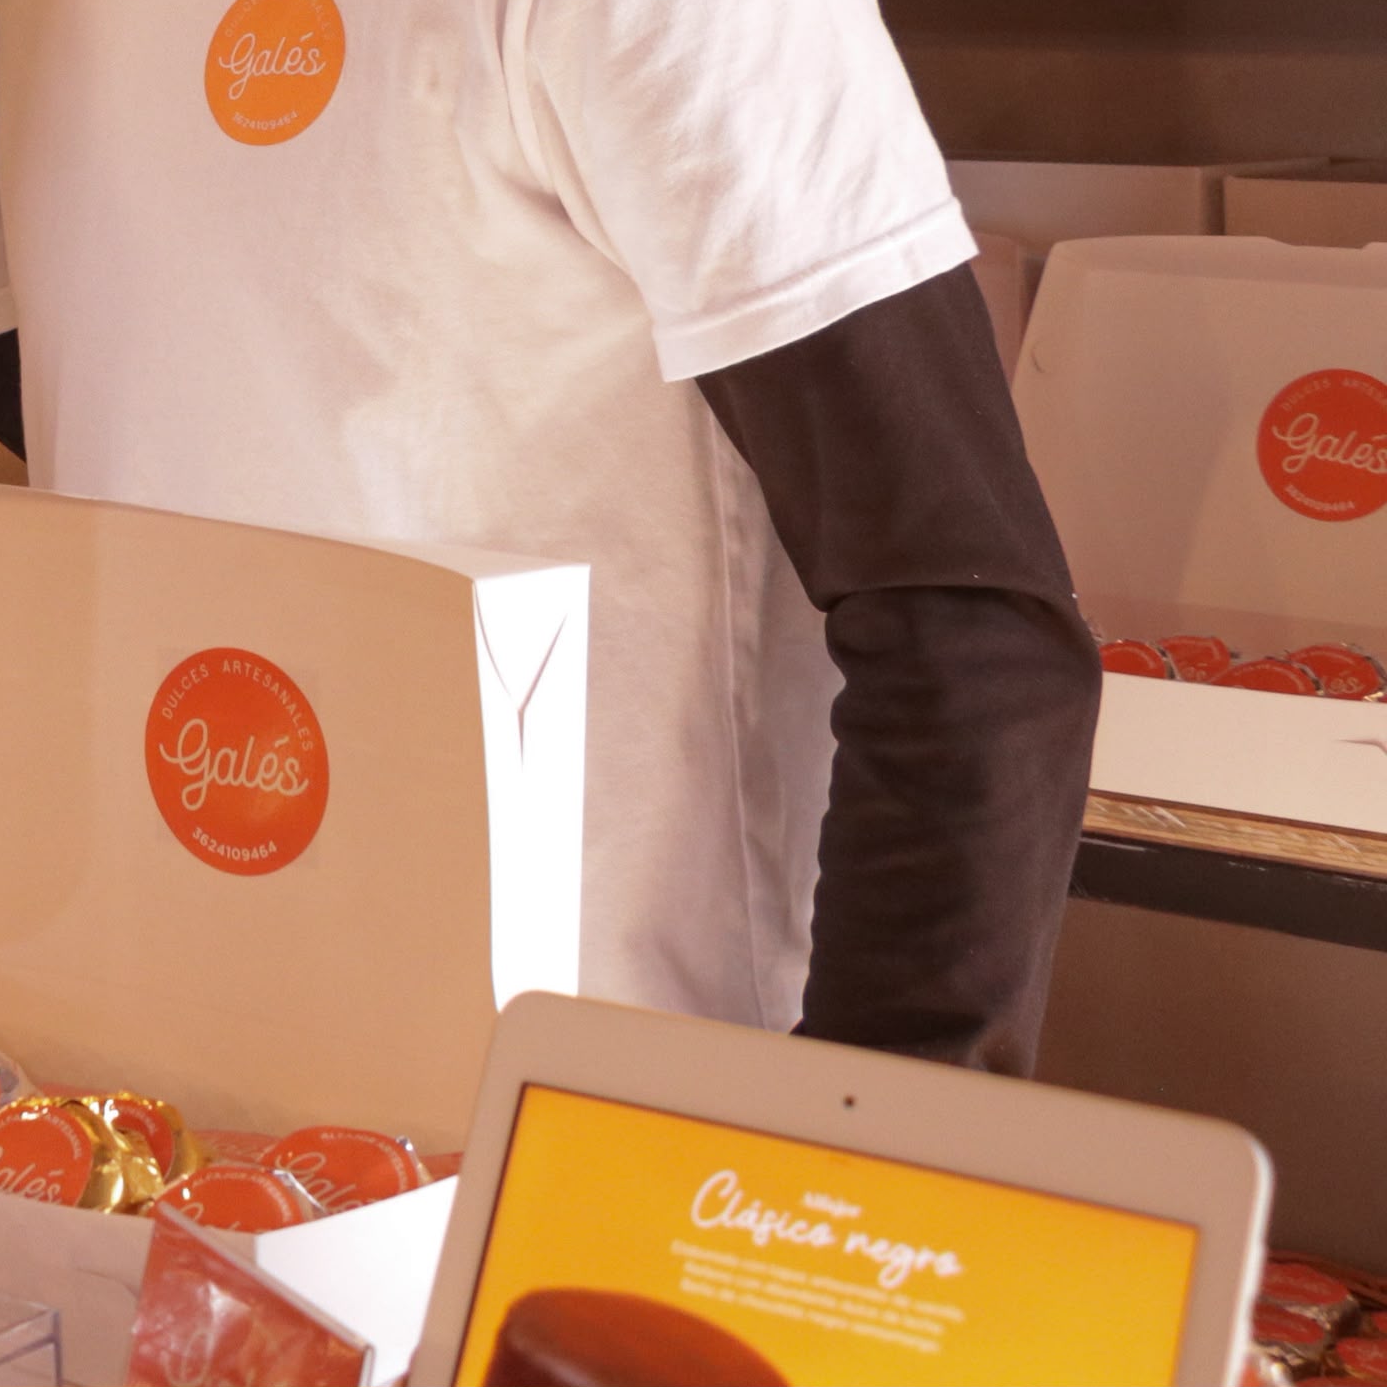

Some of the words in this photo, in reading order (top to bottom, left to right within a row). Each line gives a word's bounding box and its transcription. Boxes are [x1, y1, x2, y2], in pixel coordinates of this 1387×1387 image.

[162, 662, 210, 720] DULCES
[222, 659, 314, 752] ARTESANALES
[191, 826, 278, 862] 3624109464
[690, 1168, 837, 1247] Clásico
[842, 1230, 966, 1290] negro
